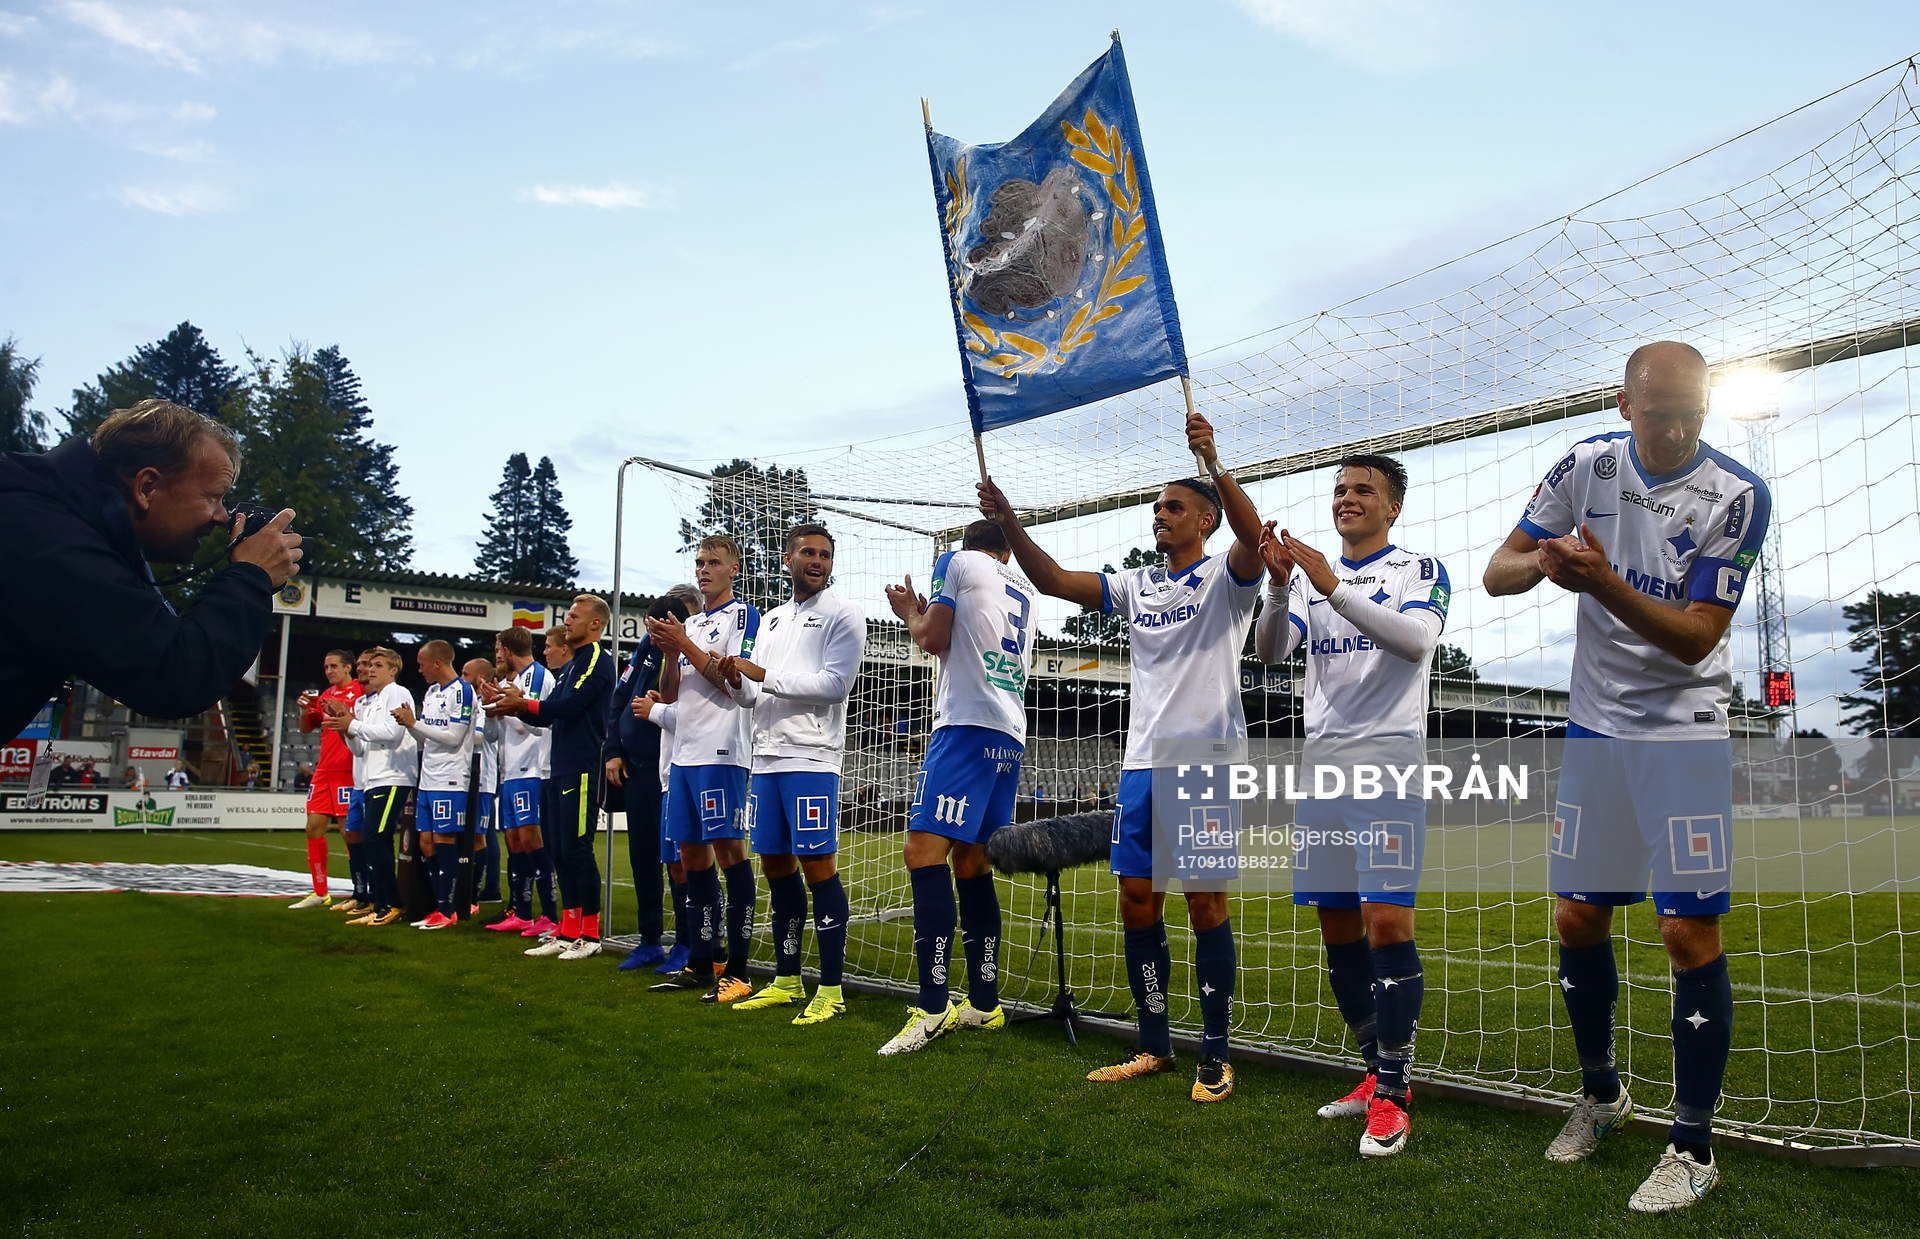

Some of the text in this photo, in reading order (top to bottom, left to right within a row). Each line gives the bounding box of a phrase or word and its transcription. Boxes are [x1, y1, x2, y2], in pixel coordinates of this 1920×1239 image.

[1716, 566, 1742, 603] C
[395, 599, 485, 615] THE BISHOPS ARMS
[1001, 584, 1030, 656] 3
[1047, 659, 1063, 674] EY
[131, 748, 177, 759] Stavdal
[117, 809, 172, 825] BOWLIGCITY
[271, 805, 305, 814] SÖDERQ
[934, 936, 948, 964] suez
[984, 936, 997, 962] suez
[1142, 962, 1159, 992] suez
